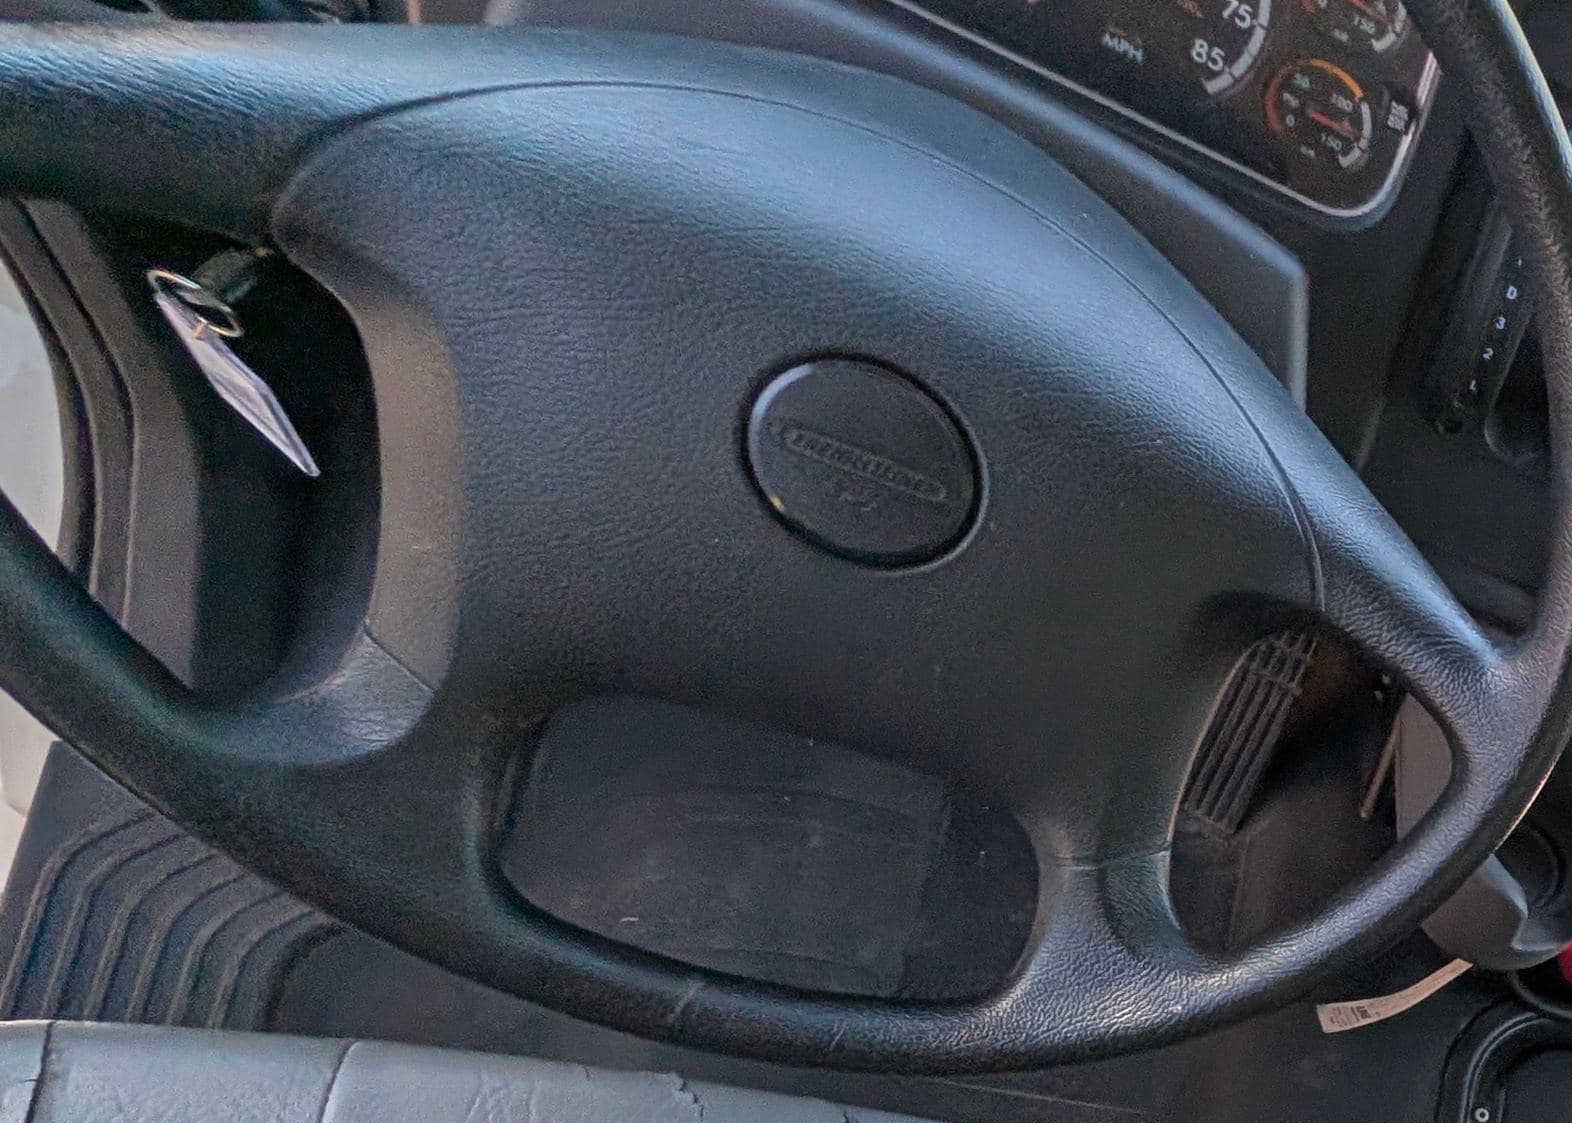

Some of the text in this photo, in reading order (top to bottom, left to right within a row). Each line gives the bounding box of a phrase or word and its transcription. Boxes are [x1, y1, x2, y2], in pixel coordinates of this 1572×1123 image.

[1222, 1, 1252, 28] 75
[1101, 31, 1144, 64] MPH
[1190, 37, 1225, 70] 85
[1494, 316, 1506, 330] 3
[1483, 347, 1494, 360] 2
